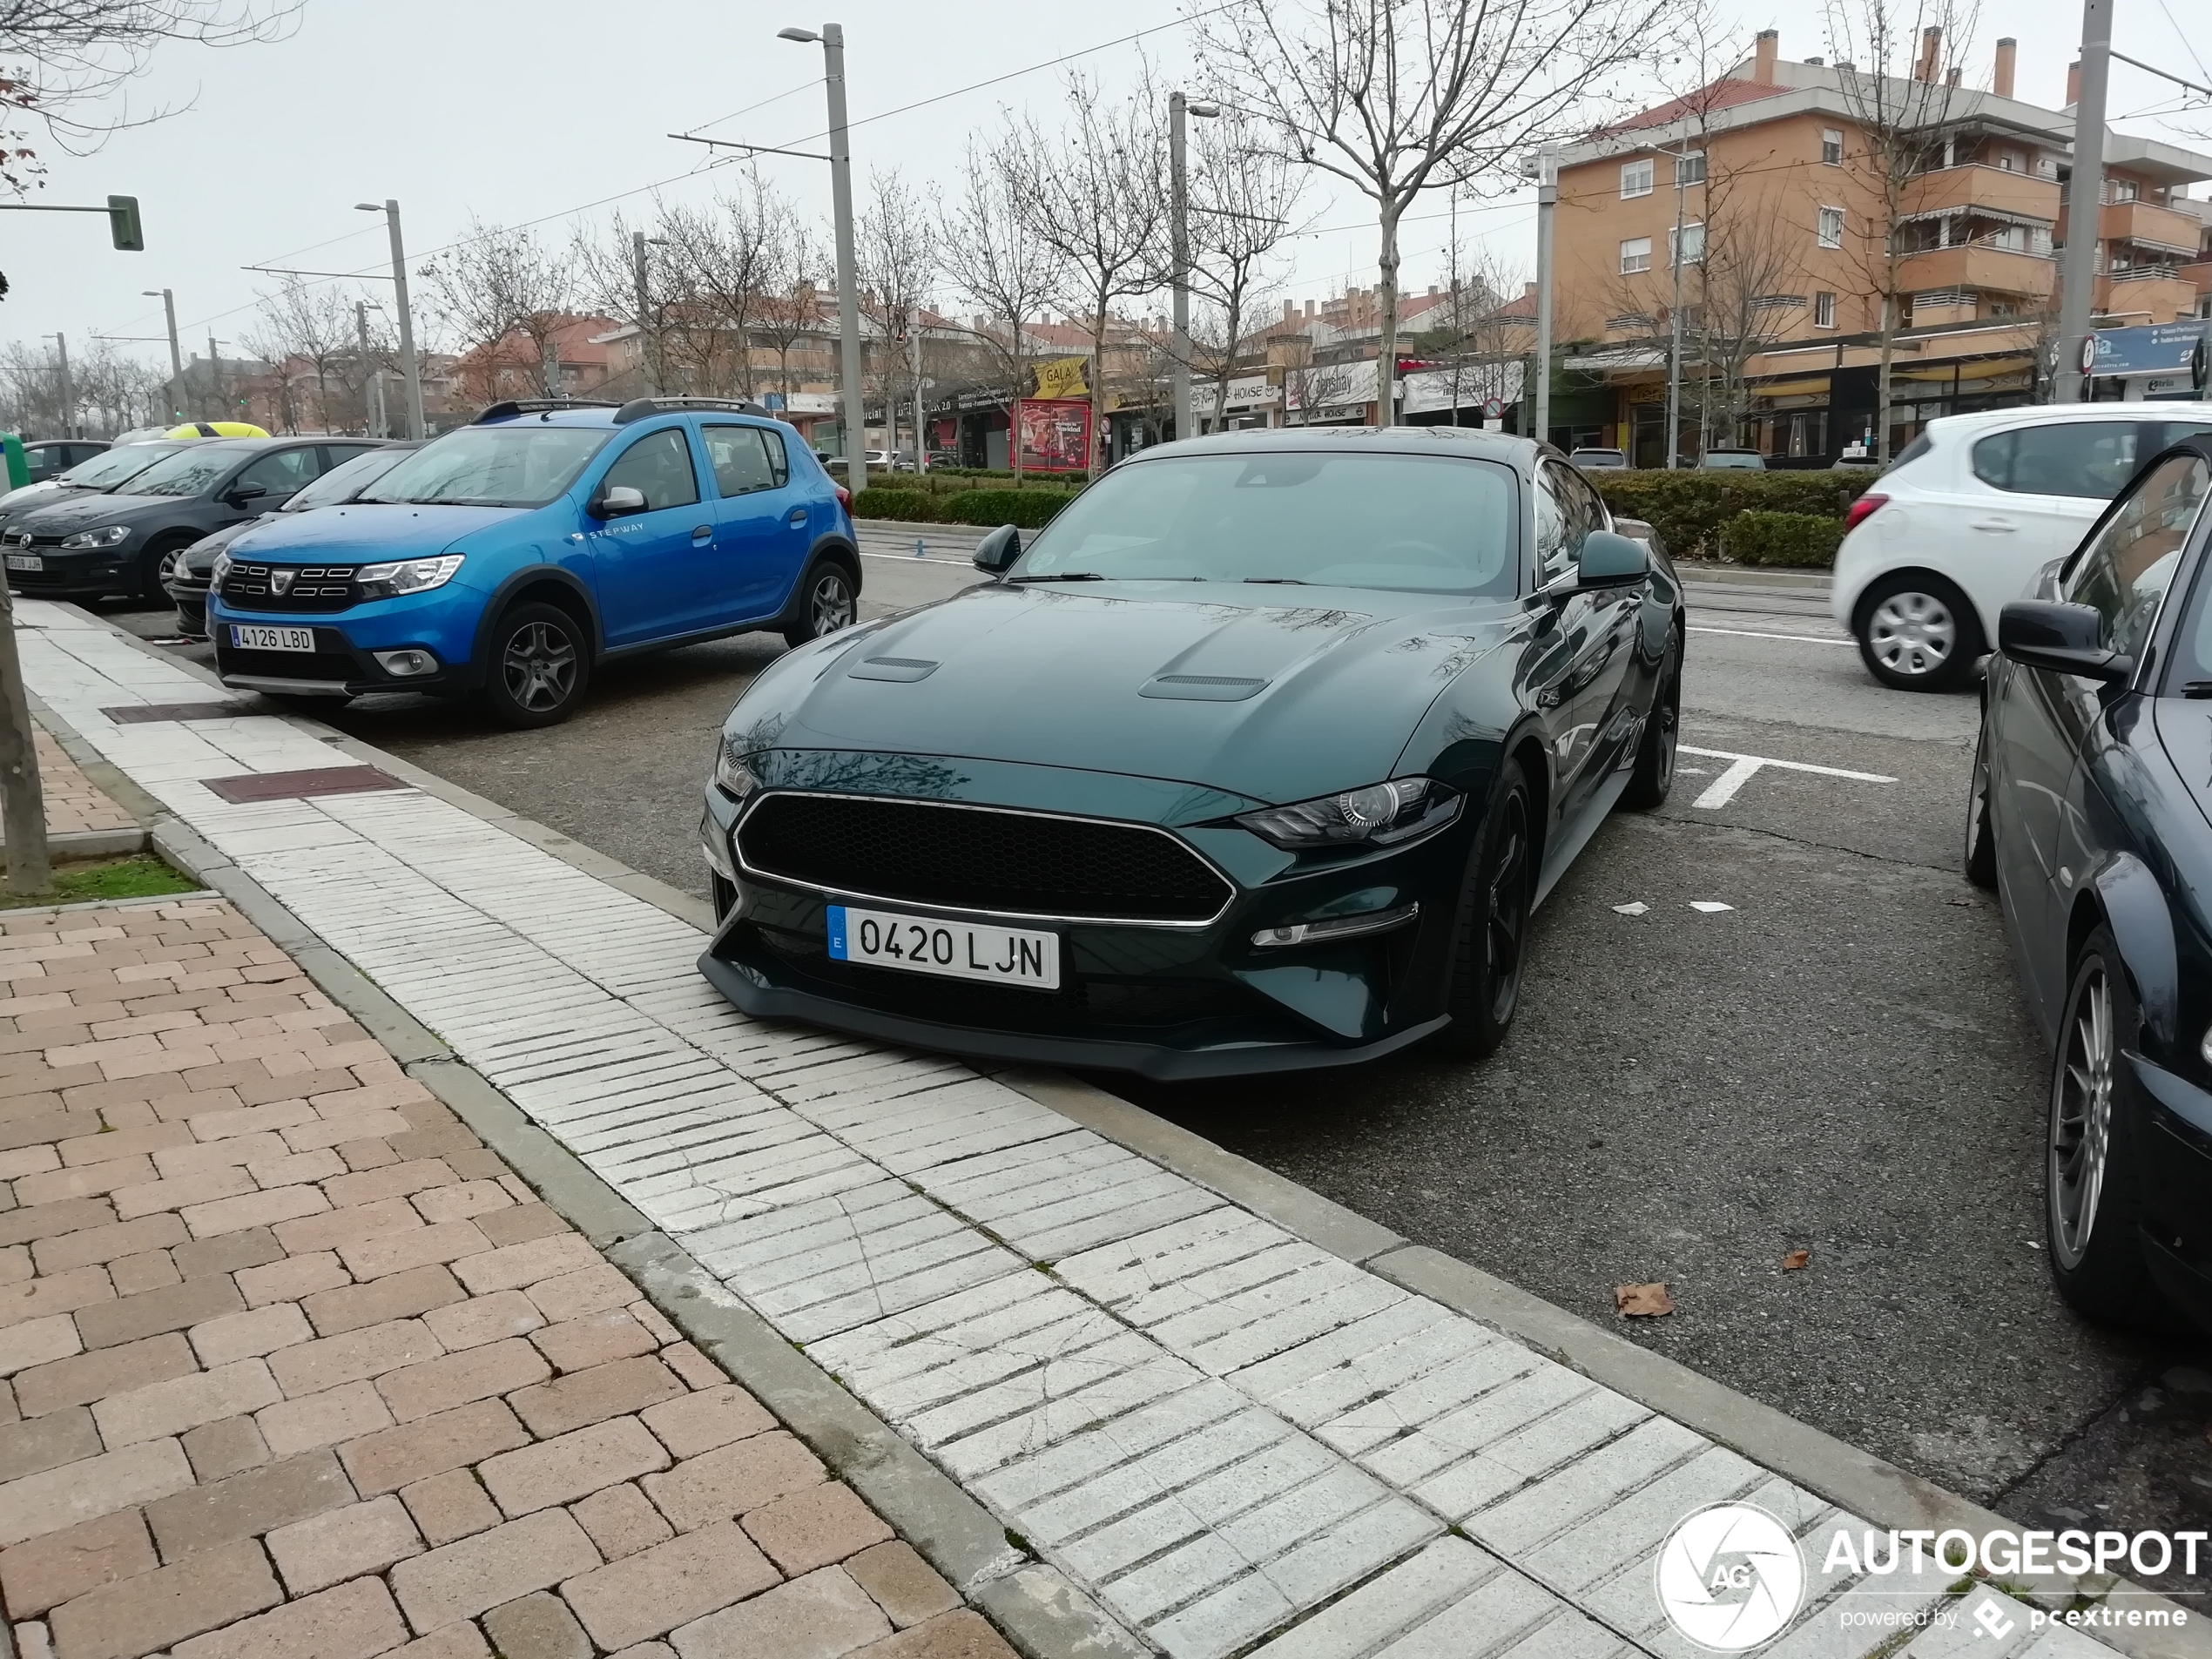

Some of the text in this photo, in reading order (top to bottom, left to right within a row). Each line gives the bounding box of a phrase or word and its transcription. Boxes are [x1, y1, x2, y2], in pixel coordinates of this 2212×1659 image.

[1046, 367, 1072, 381] GALA
[1233, 386, 1263, 401] HOUSE
[1325, 408, 1347, 418] HOUSE
[590, 523, 644, 539] STEPWAY
[242, 629, 278, 647] 4126
[280, 631, 310, 649] LBD
[833, 919, 1042, 977] E 0420 LJN
